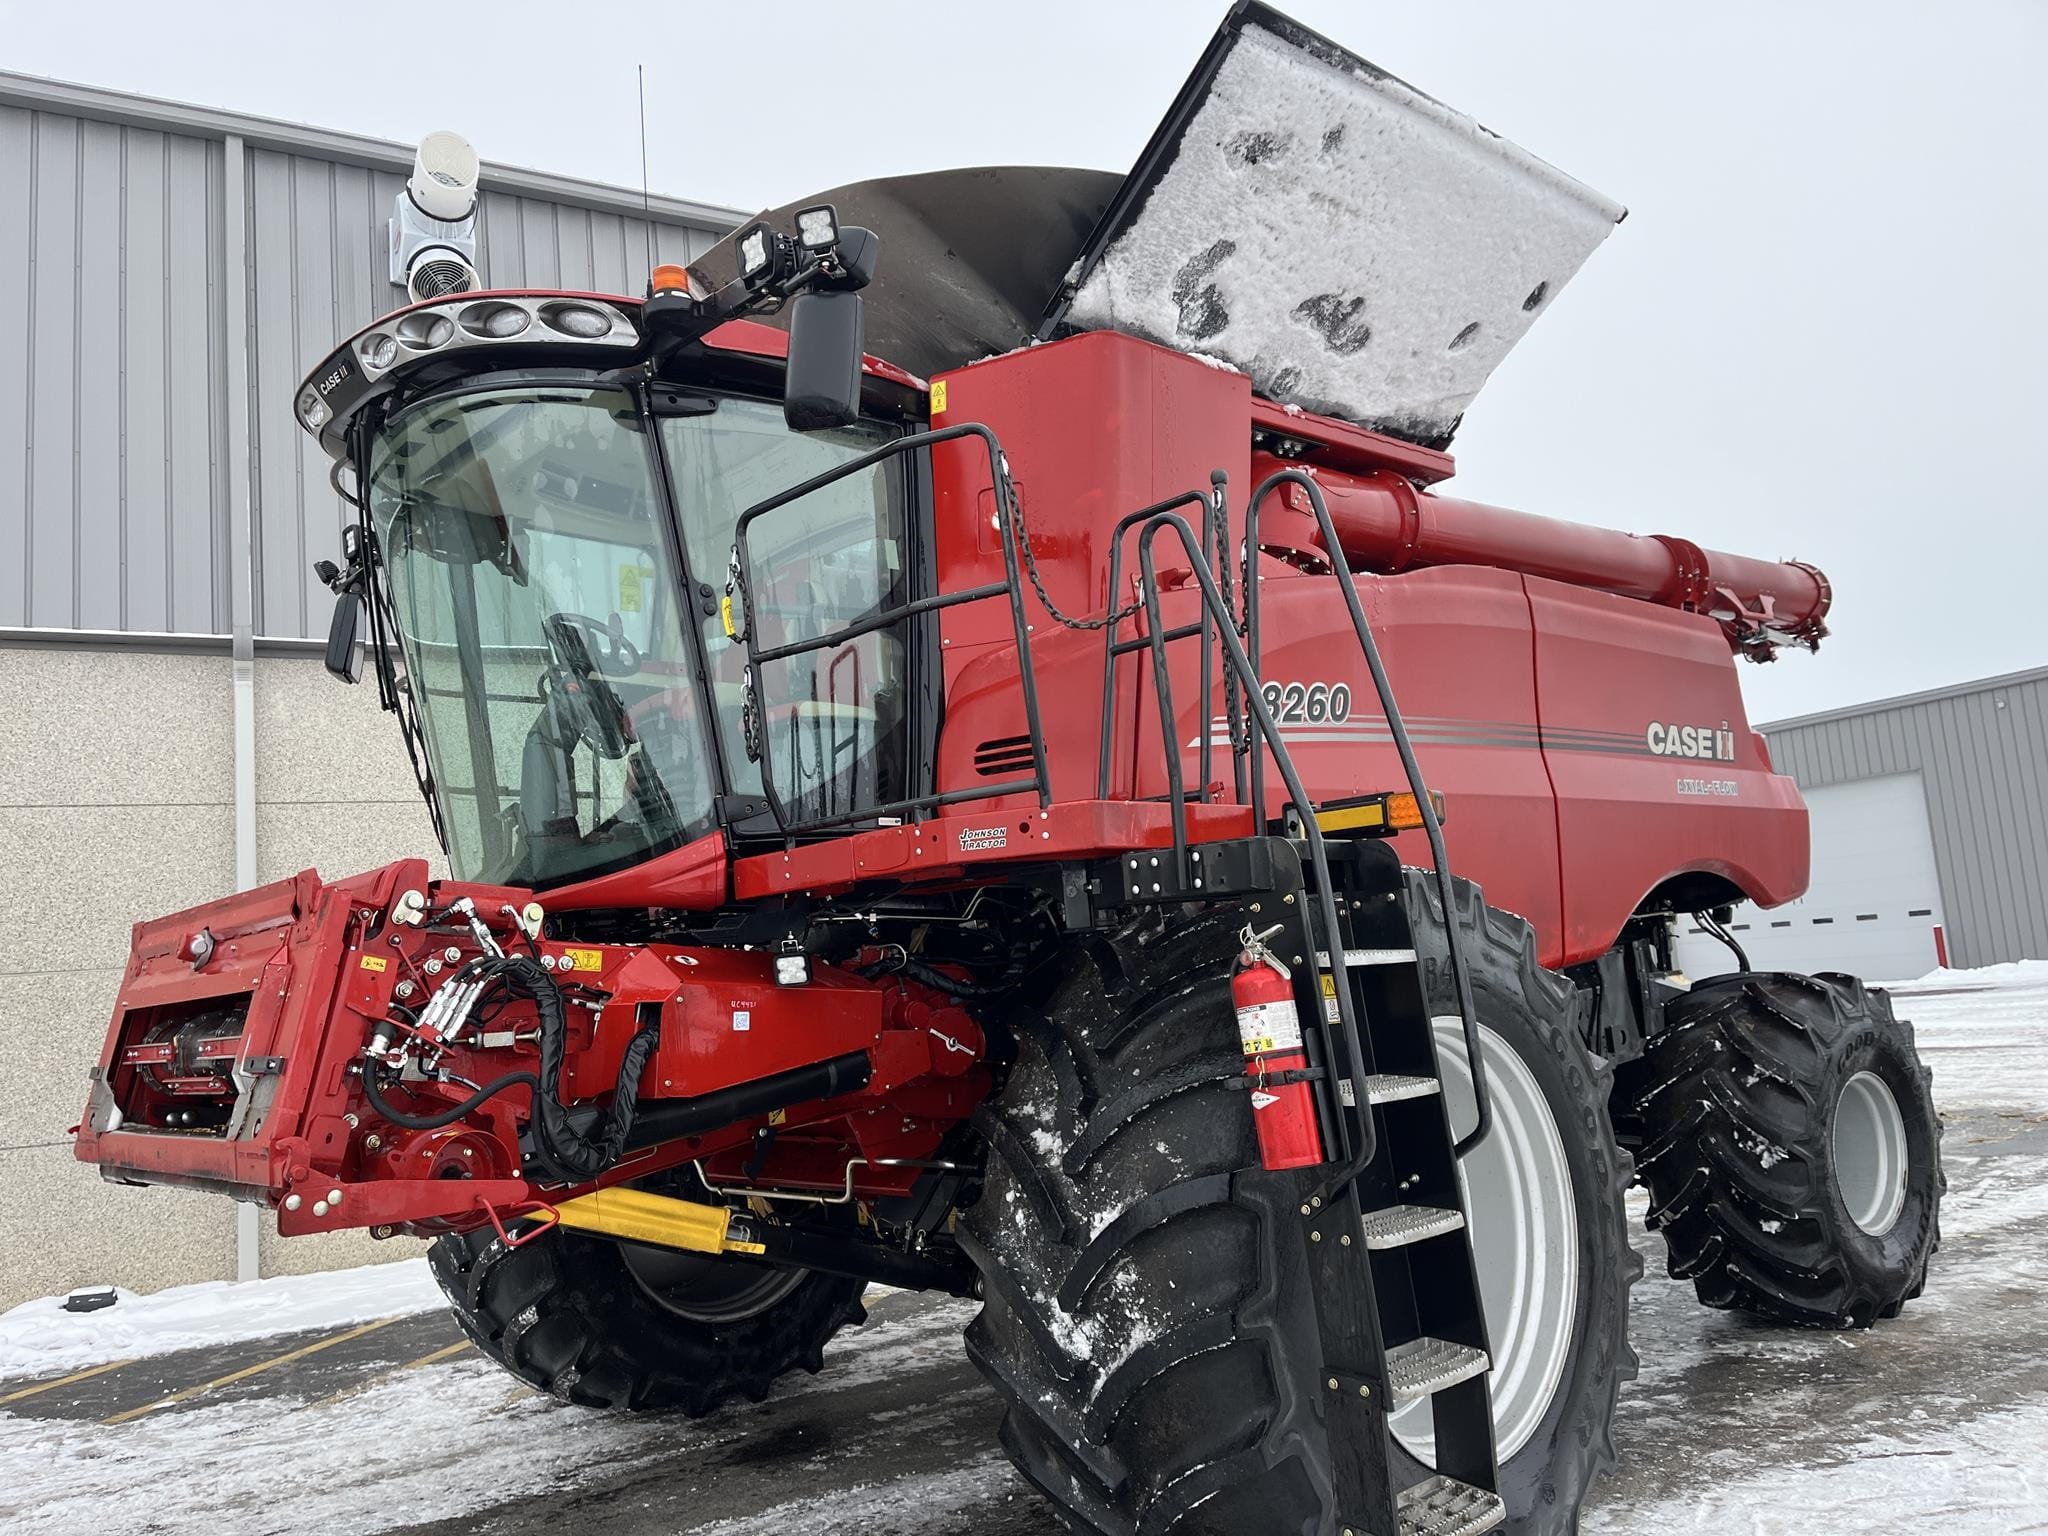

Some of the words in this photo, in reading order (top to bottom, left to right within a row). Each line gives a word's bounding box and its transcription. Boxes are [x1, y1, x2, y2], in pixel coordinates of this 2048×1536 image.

[320, 371, 341, 395] CASE
[1261, 681, 1351, 725] 8260
[1647, 721, 1713, 757] CASE
[1677, 779, 1738, 796] AXIAL-FLOW
[959, 827, 1007, 840] JOHNSON
[960, 838, 1006, 851] TRACTOR
